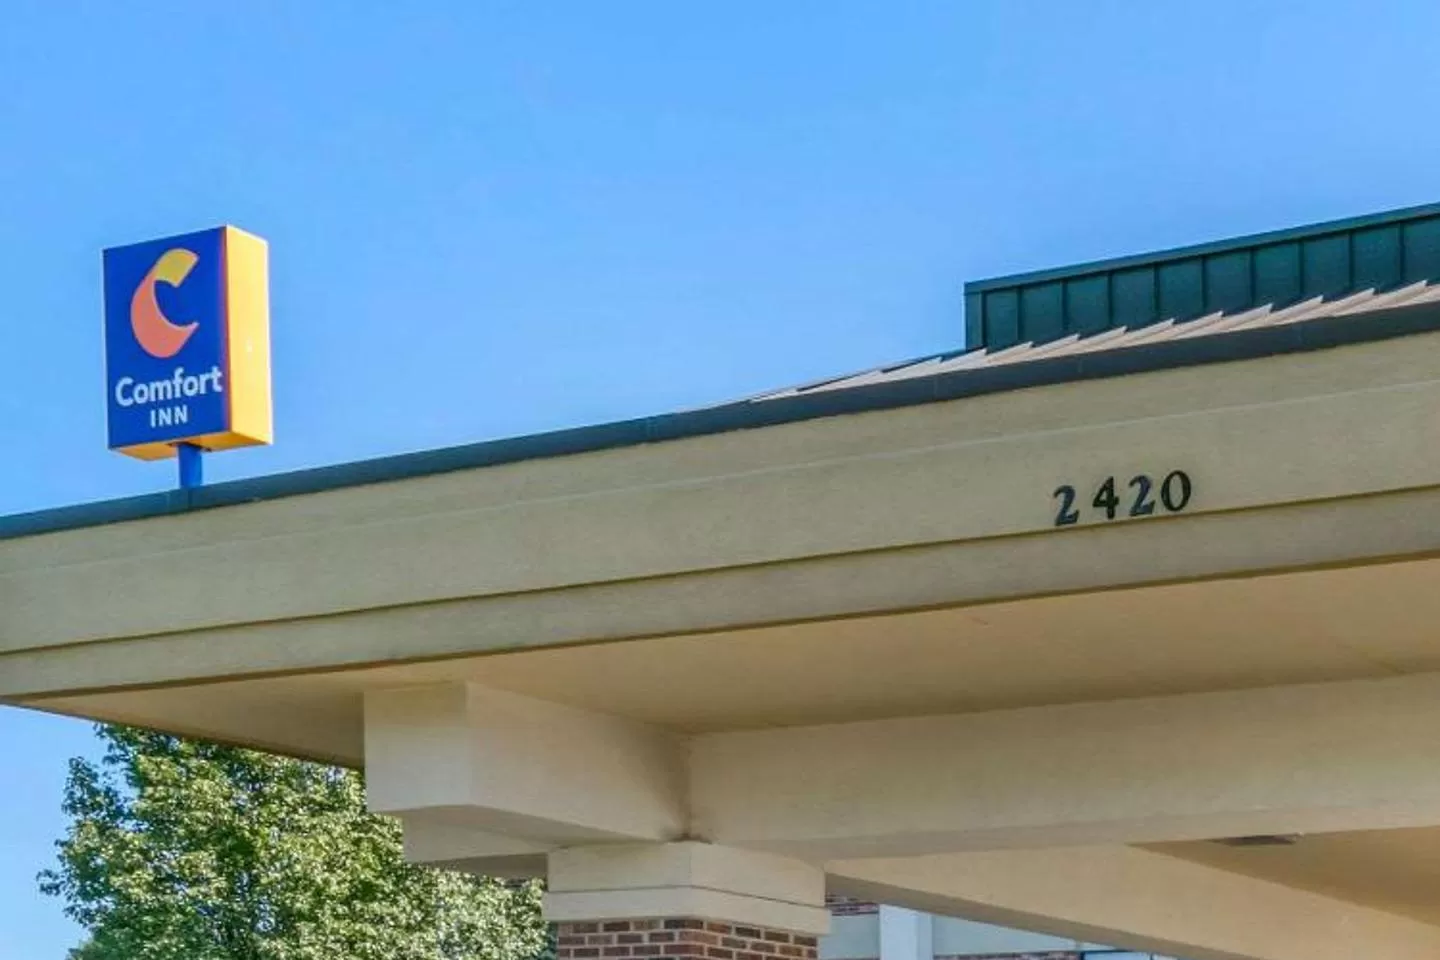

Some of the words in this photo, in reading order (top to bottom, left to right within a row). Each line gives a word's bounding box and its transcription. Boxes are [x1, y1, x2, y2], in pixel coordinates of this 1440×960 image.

[115, 365, 223, 407] Comfort
[150, 405, 189, 428] INN
[1053, 470, 1192, 526] 2420
